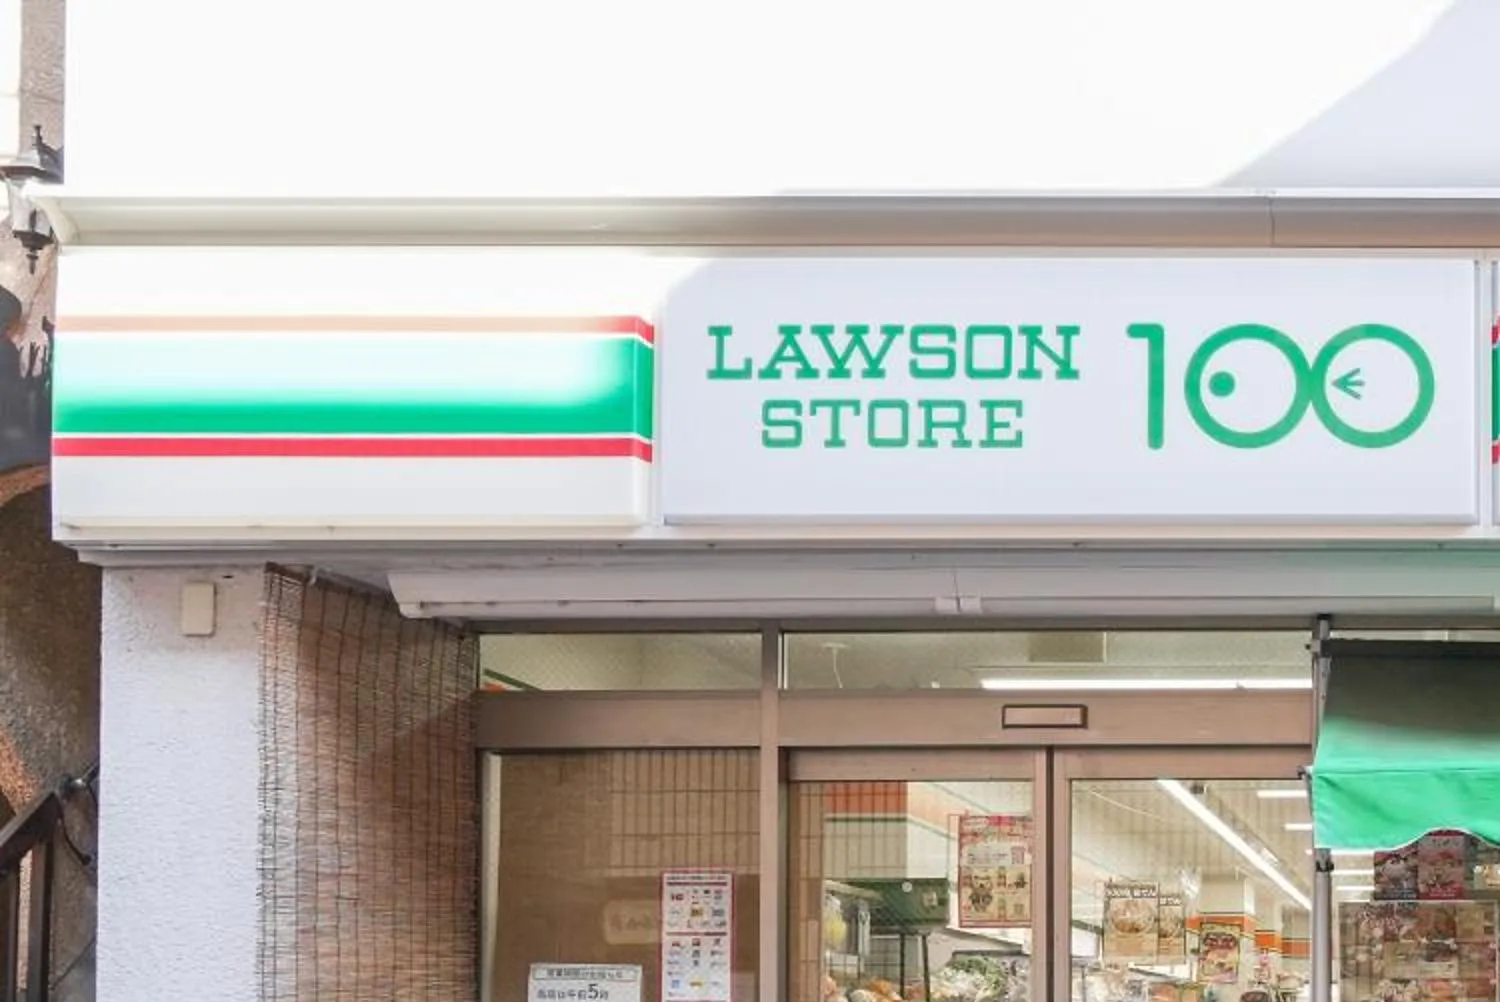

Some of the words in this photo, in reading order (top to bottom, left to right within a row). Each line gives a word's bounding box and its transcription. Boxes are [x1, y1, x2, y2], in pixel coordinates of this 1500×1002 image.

[707, 325, 1080, 379] LAWSON
[1127, 323, 1436, 450] 100
[761, 400, 1024, 448] STORE
